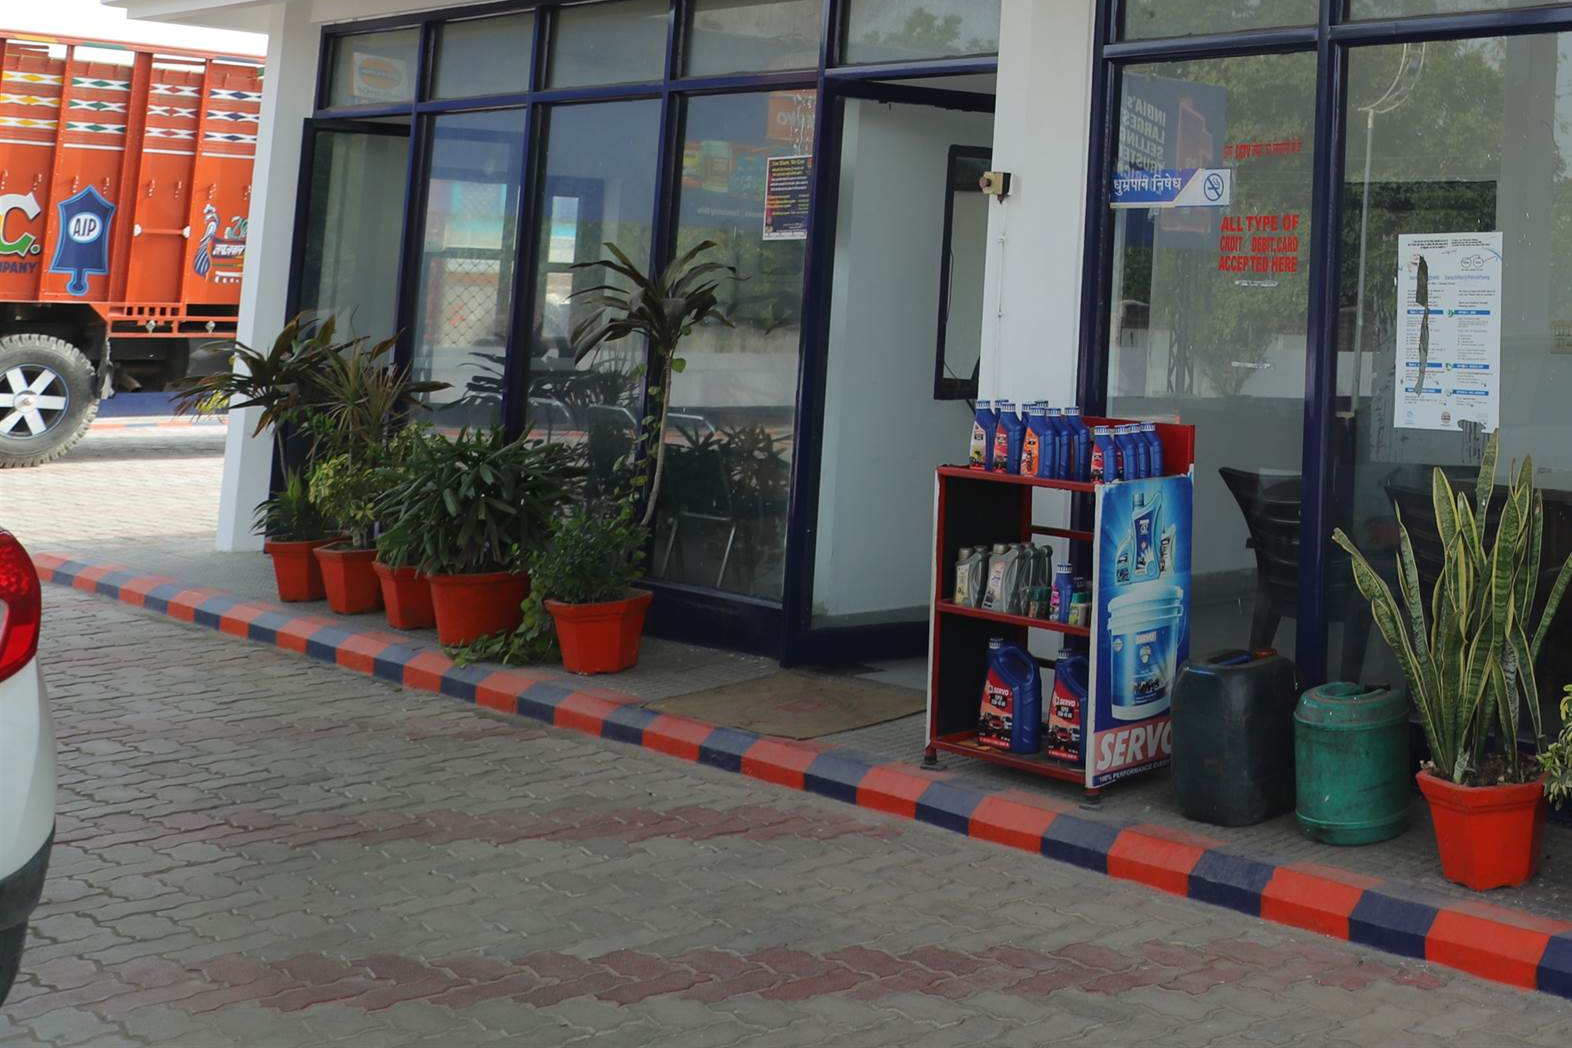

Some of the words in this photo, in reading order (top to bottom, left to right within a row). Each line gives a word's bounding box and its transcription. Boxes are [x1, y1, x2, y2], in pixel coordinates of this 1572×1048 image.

[1221, 215, 1243, 233] ALL
[1245, 214, 1279, 232] TYPE
[1282, 214, 1300, 232] OF
[1271, 255, 1298, 273] HERE
